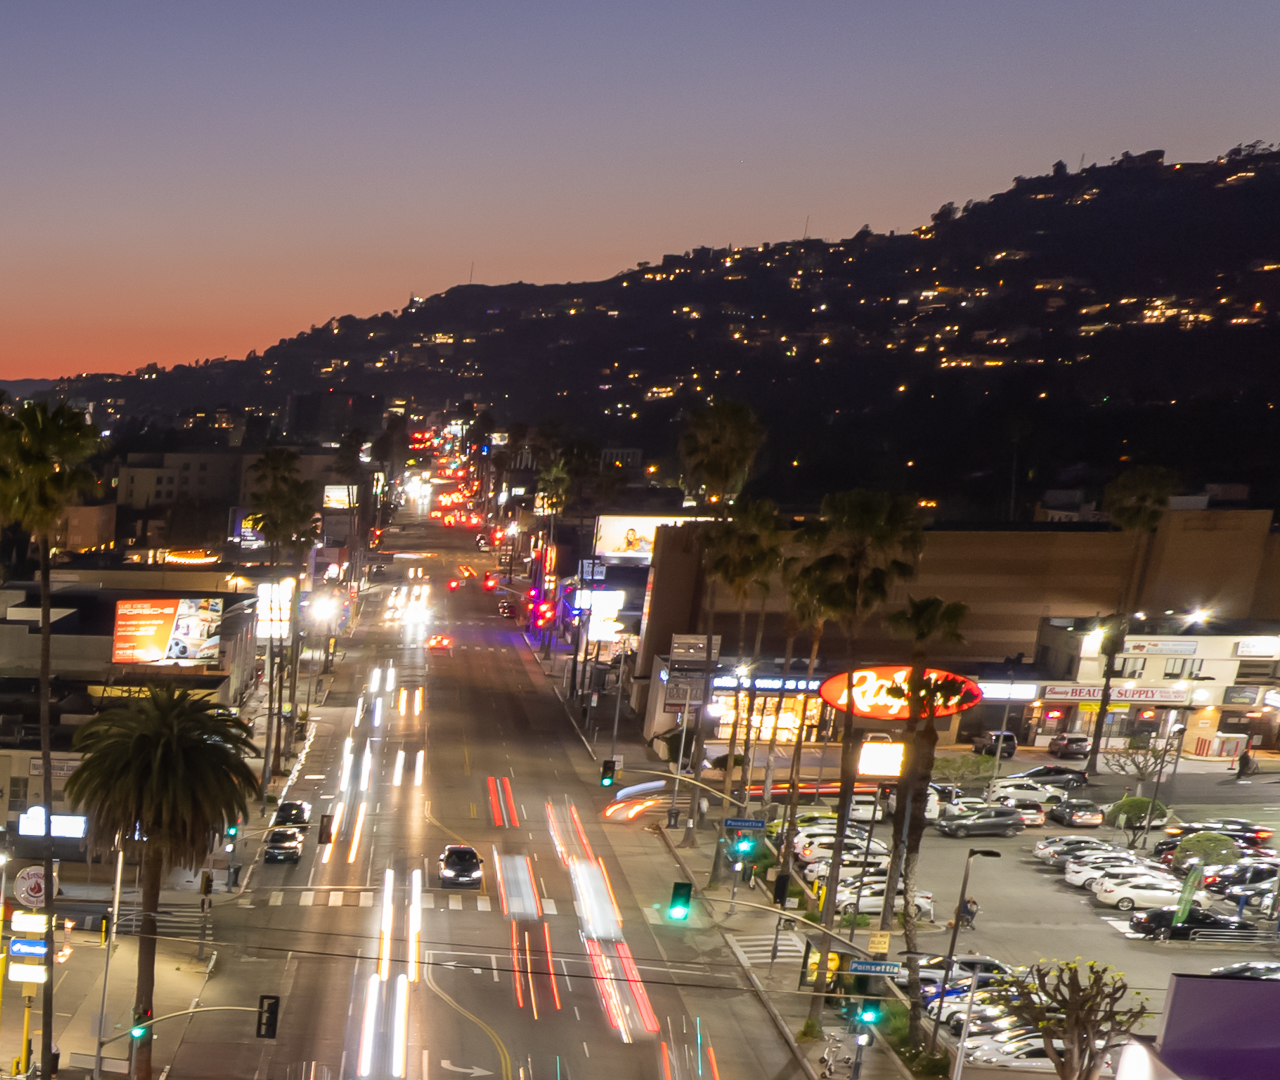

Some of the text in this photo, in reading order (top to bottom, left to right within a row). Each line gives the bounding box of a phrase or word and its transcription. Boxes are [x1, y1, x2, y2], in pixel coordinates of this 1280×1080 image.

[118, 607, 174, 615] PORSCHE
[1071, 688, 1158, 699] BEAUT SUPPLY
[851, 962, 899, 973] Poinsettia
